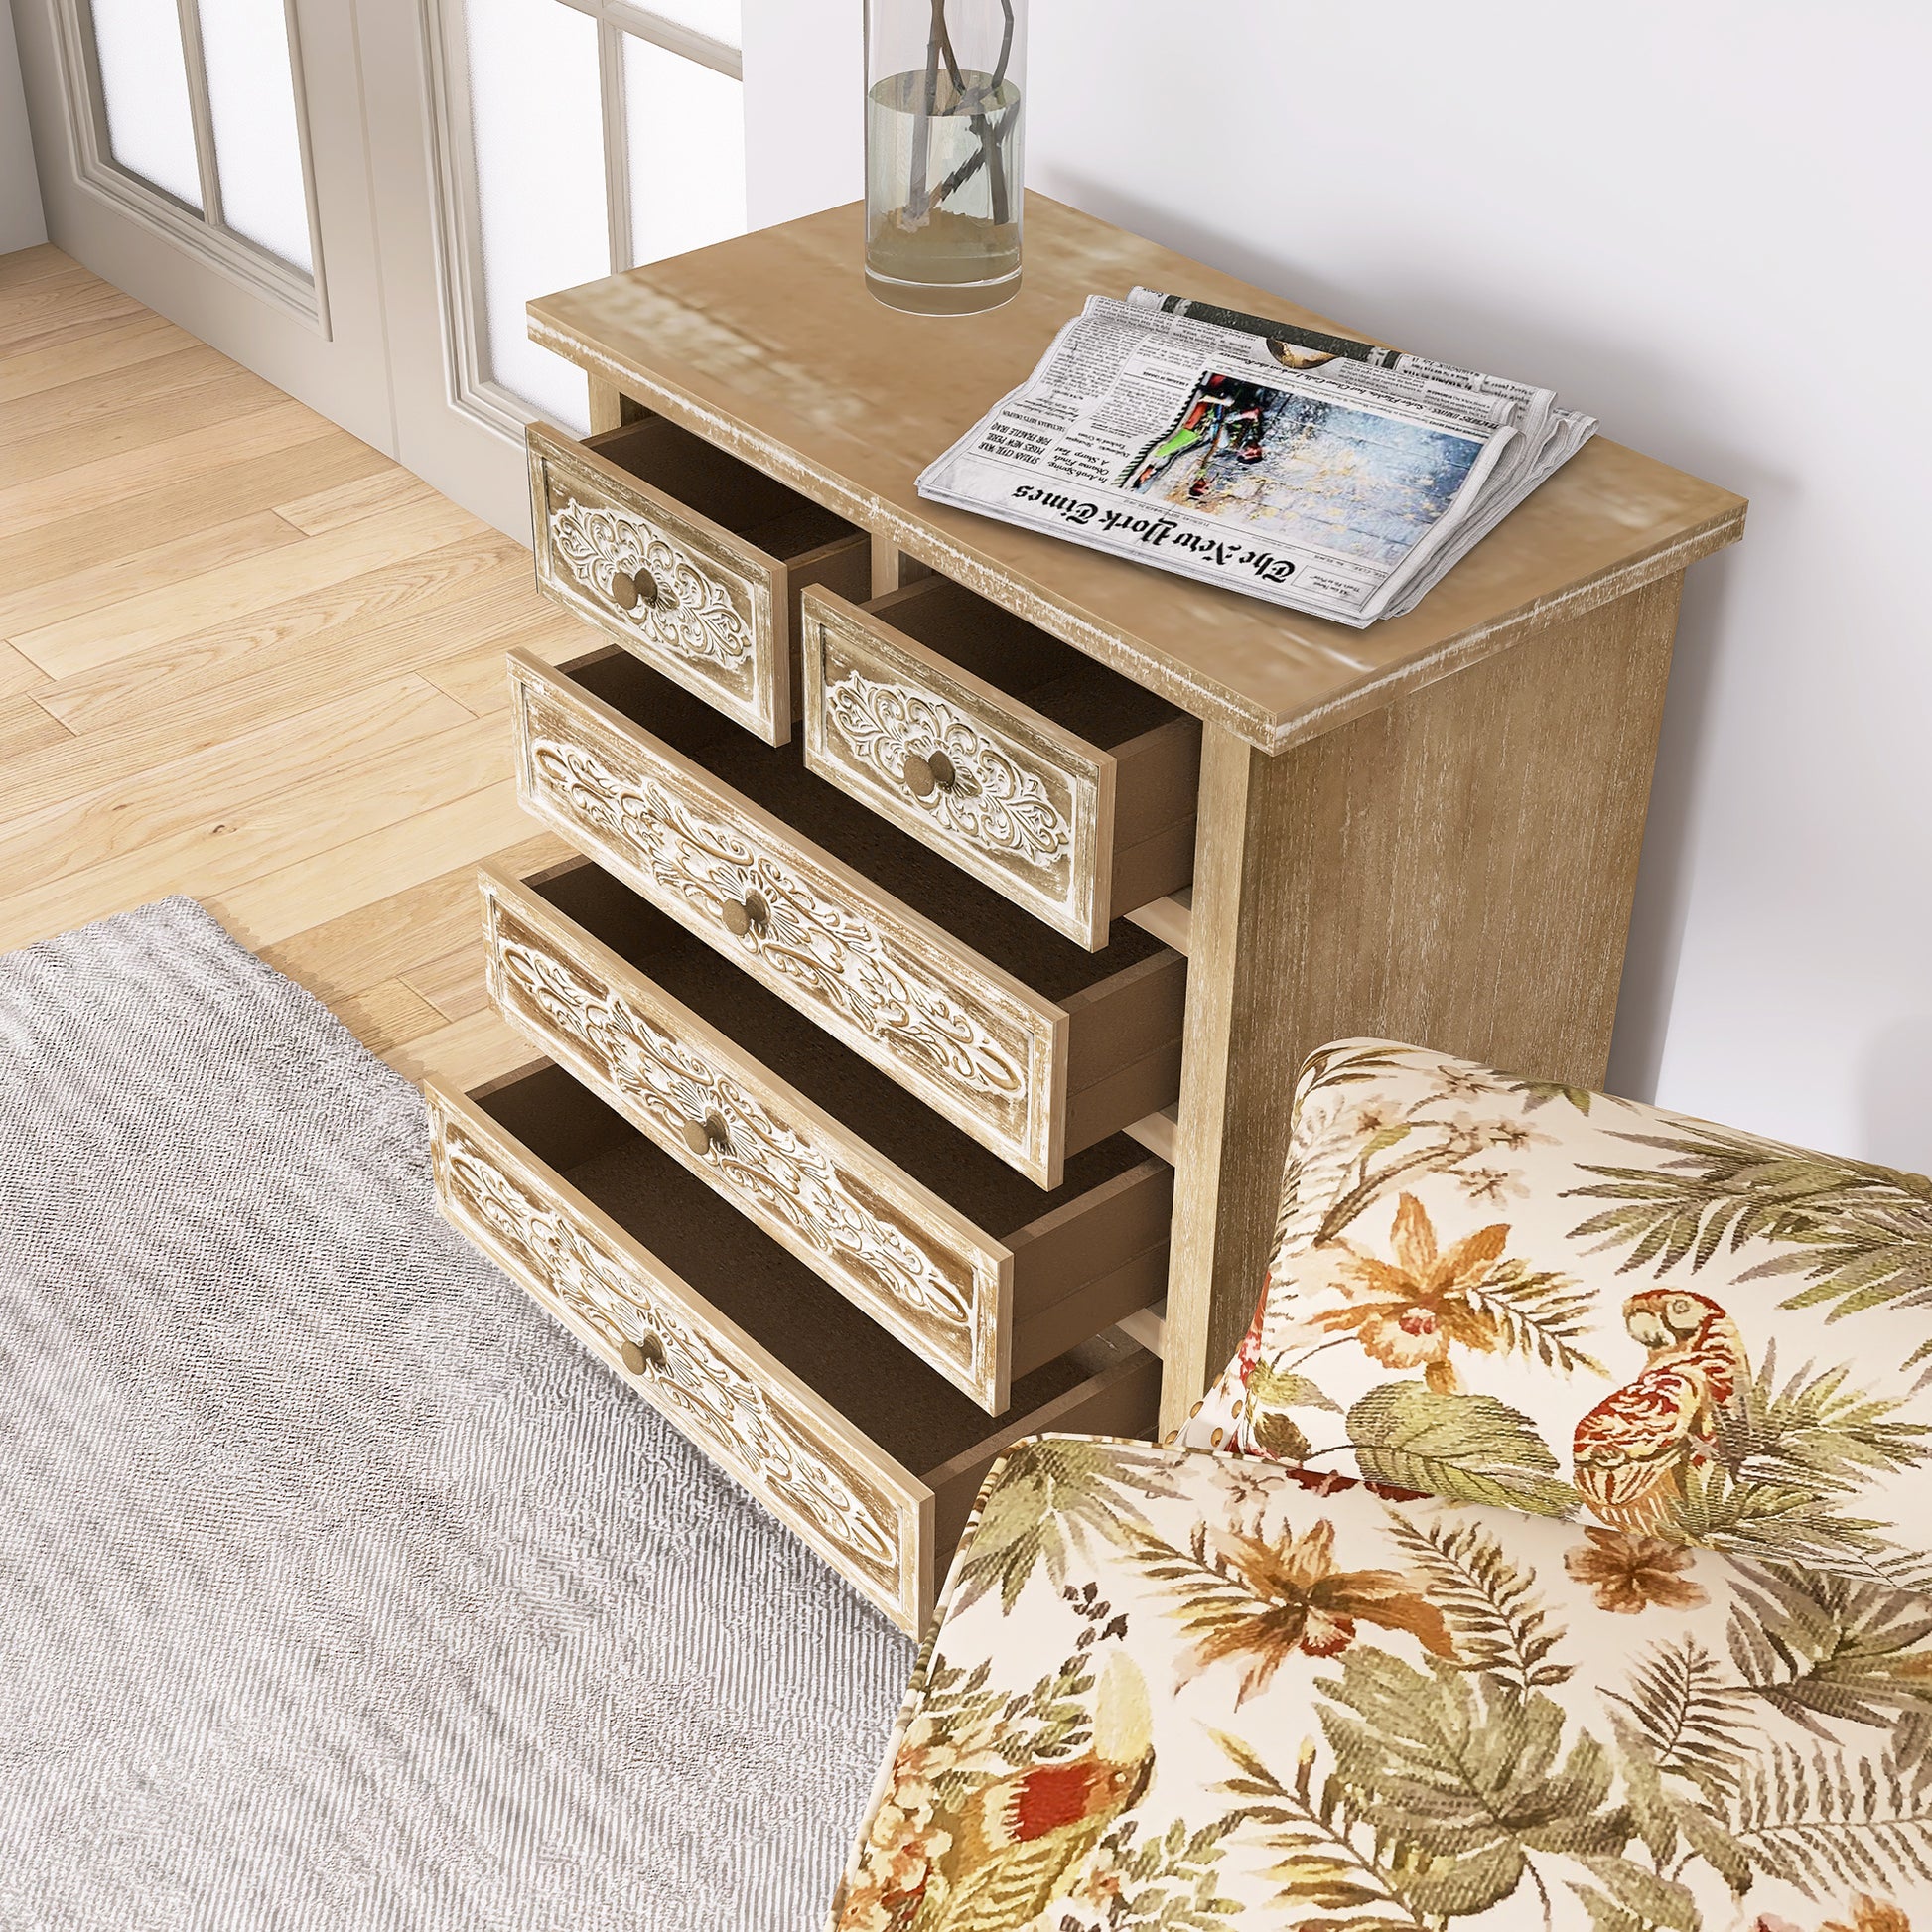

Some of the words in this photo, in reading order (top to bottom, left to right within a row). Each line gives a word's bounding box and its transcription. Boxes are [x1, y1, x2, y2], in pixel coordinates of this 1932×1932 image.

[991, 420, 1010, 433] IRAQ
[986, 432, 1007, 444] PERIL
[1008, 428, 1037, 441] FRAGILE
[1035, 436, 1051, 445] FOR
[978, 442, 995, 452] WAR
[1005, 439, 1023, 448] NEW
[1023, 443, 1045, 455] POSES
[995, 446, 1014, 457] CIVIL
[1054, 447, 1071, 456] Test
[1074, 452, 1100, 463] Sharp
[1013, 452, 1040, 465] SYRIAN
[1053, 455, 1077, 466] Finds
[1047, 461, 1075, 475] Spring,
[1078, 462, 1109, 476] Obama
[1074, 470, 1095, 480] Arab
[1011, 485, 1098, 524] Times
[1098, 510, 1178, 546] York
[1172, 533, 1242, 565] New
[1239, 551, 1295, 583] The
